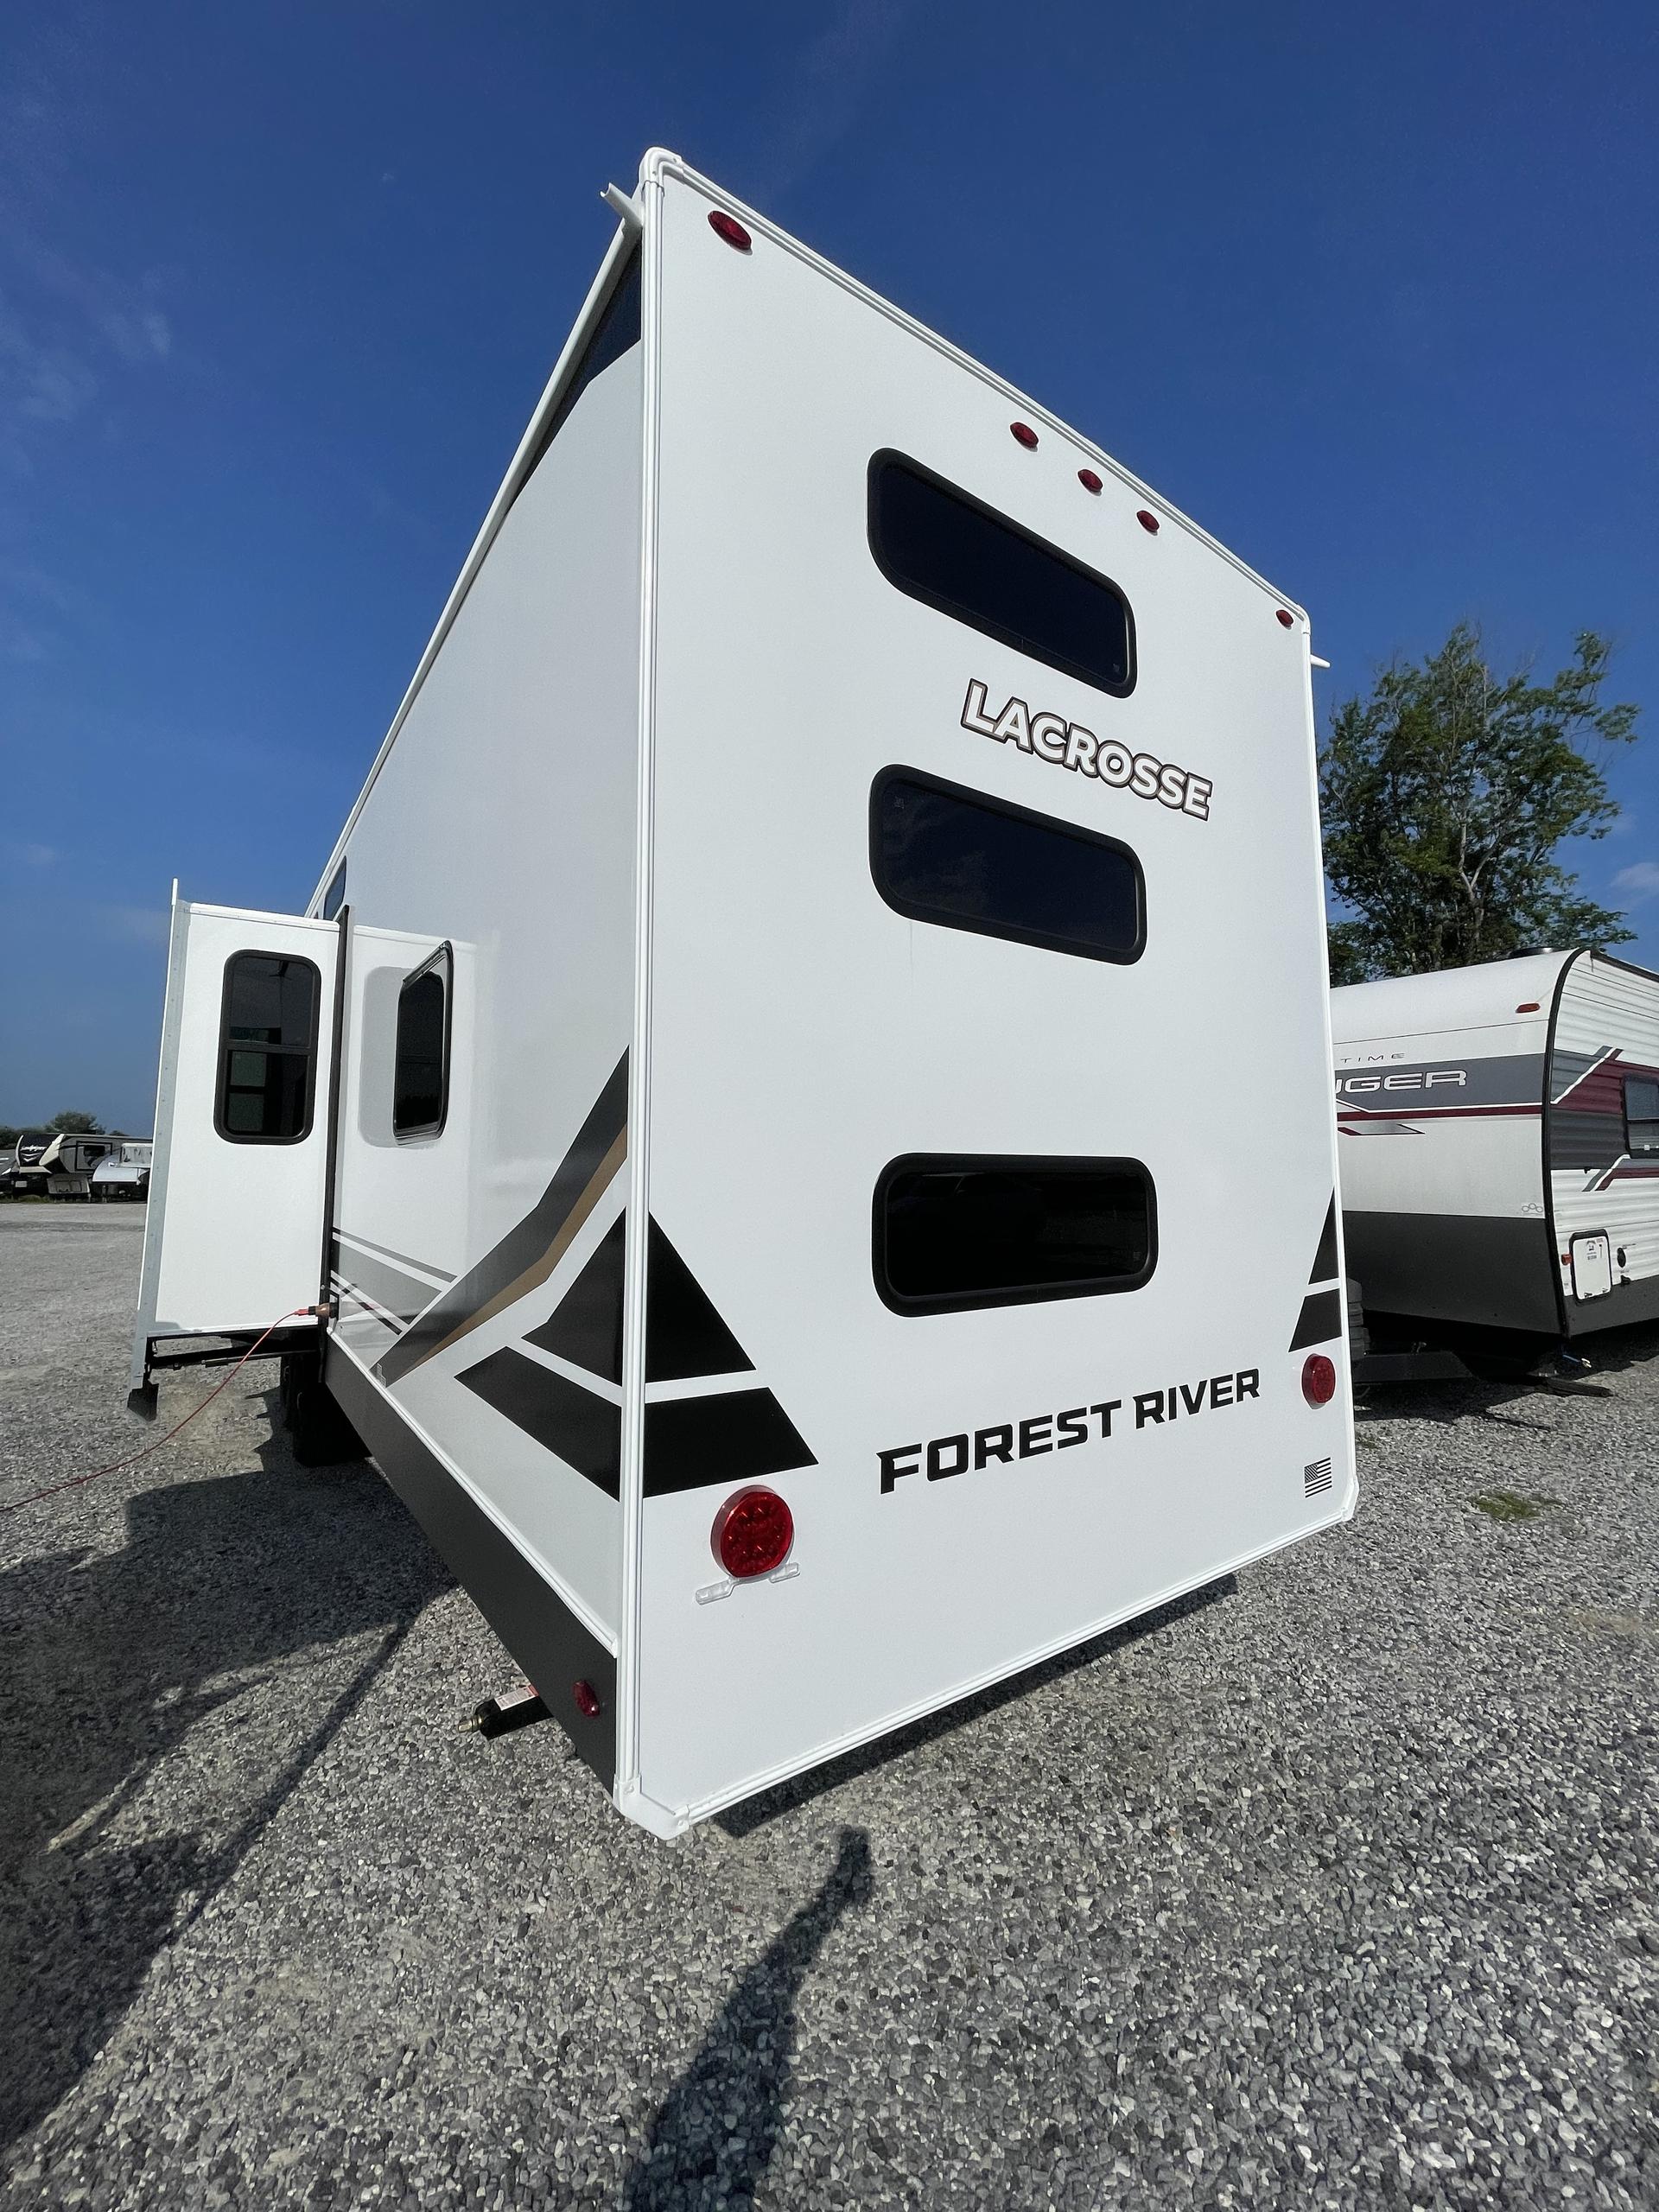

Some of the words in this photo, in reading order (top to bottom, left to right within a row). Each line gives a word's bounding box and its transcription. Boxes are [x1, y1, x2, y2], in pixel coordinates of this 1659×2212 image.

[960, 677, 1213, 821] LACROSSE
[1336, 1070, 1467, 1094] GER
[1341, 1052, 1405, 1064] TIME
[875, 1399, 1122, 1495] FOREST
[1133, 1368, 1261, 1429] RIVER
